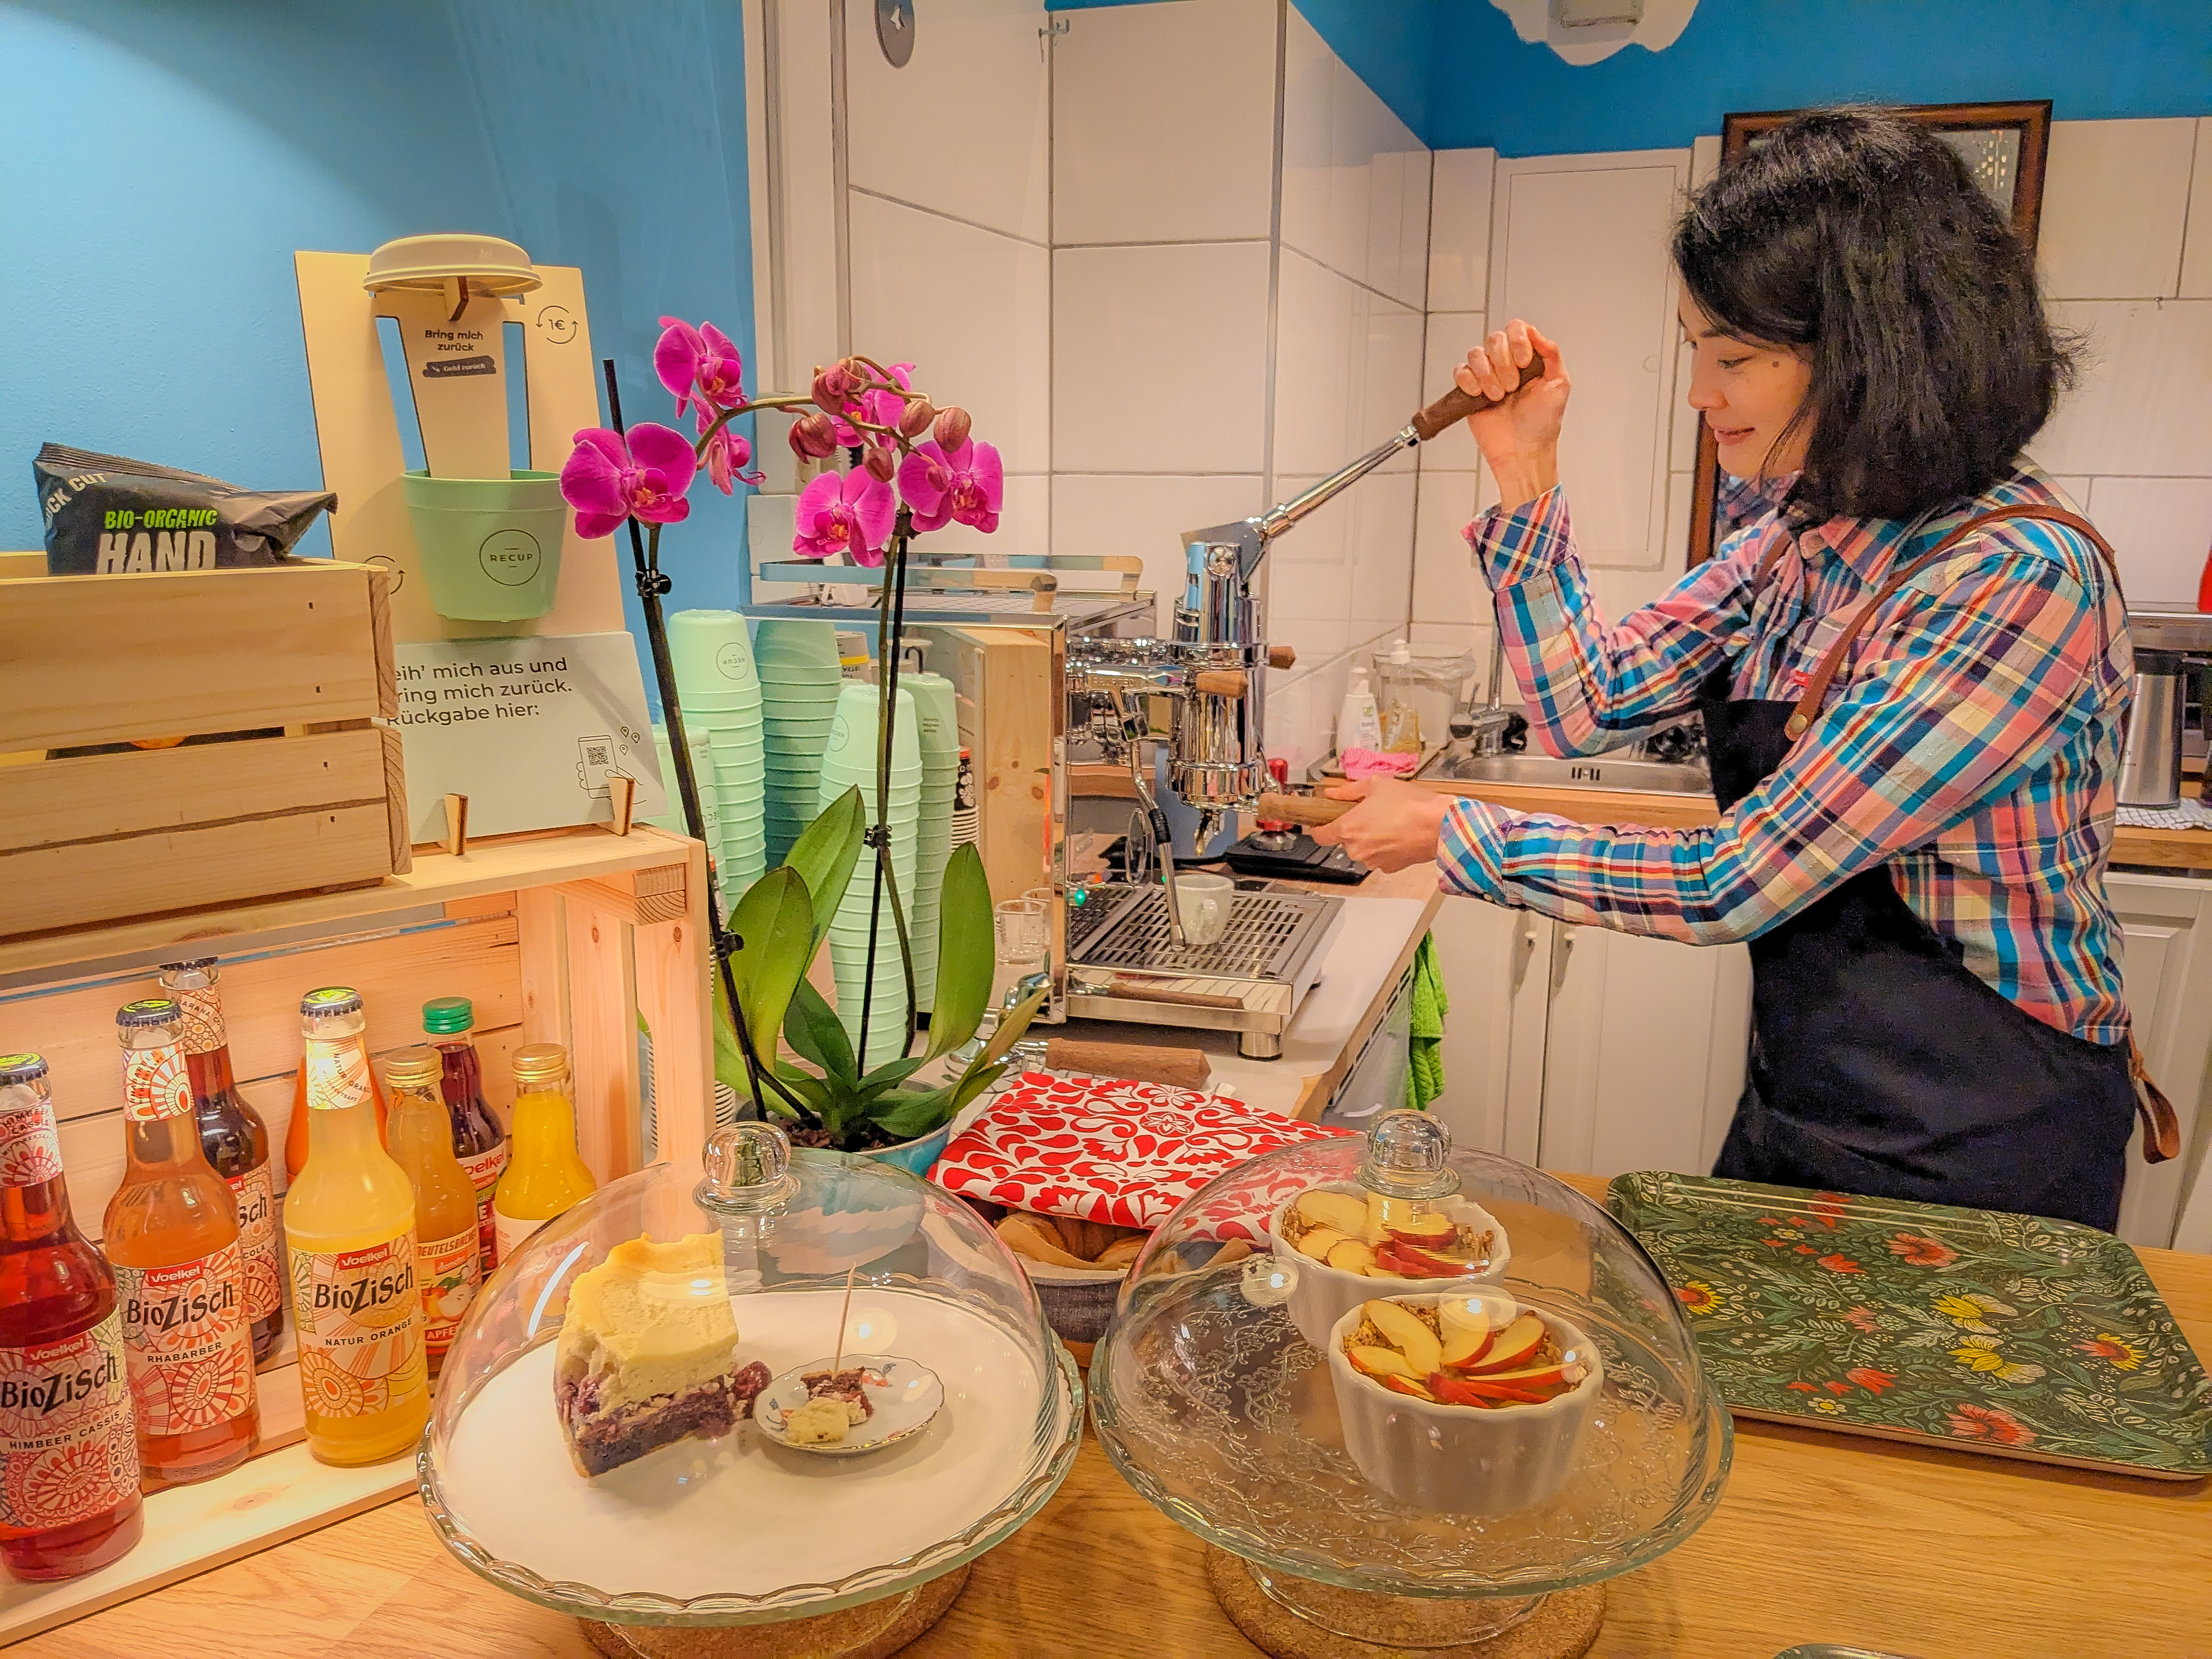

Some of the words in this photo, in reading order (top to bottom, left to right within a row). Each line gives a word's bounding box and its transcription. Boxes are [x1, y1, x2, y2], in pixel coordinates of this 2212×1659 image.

[425, 329, 454, 341] Bring
[457, 330, 483, 340] mich
[548, 319, 566, 330] 1€
[437, 342, 475, 352] zurück
[69, 473, 107, 492] CUT
[105, 509, 218, 529] BIO-ORGANIC
[96, 531, 217, 574] HAND
[490, 554, 533, 562] RECUP
[396, 664, 425, 681] eih'
[432, 662, 483, 679] mich
[489, 663, 524, 675] aus
[529, 657, 568, 673] und
[398, 687, 437, 704] ring
[444, 683, 494, 700] mich
[499, 678, 572, 696] zurück.
[387, 706, 490, 726] Rückgabe
[495, 702, 540, 718] hier:
[334, 1052, 347, 1080] NATUR
[462, 1148, 505, 1175] oelkel
[242, 1244, 266, 1259] COLA
[341, 1248, 388, 1267] Voelkel
[150, 1265, 201, 1283] Voelkel
[314, 1262, 414, 1317] BioZisch
[127, 1280, 234, 1334] BioZisch
[325, 1336, 365, 1346] NATUR
[370, 1317, 412, 1341] ORANGE
[426, 1327, 456, 1340] APFE
[30, 1338, 84, 1361] Voelkel
[147, 1341, 223, 1363] RHABARBER
[1, 1352, 118, 1416] BioZisch
[9, 1434, 72, 1449] HIMBEER
[79, 1410, 120, 1437] CASSIS
